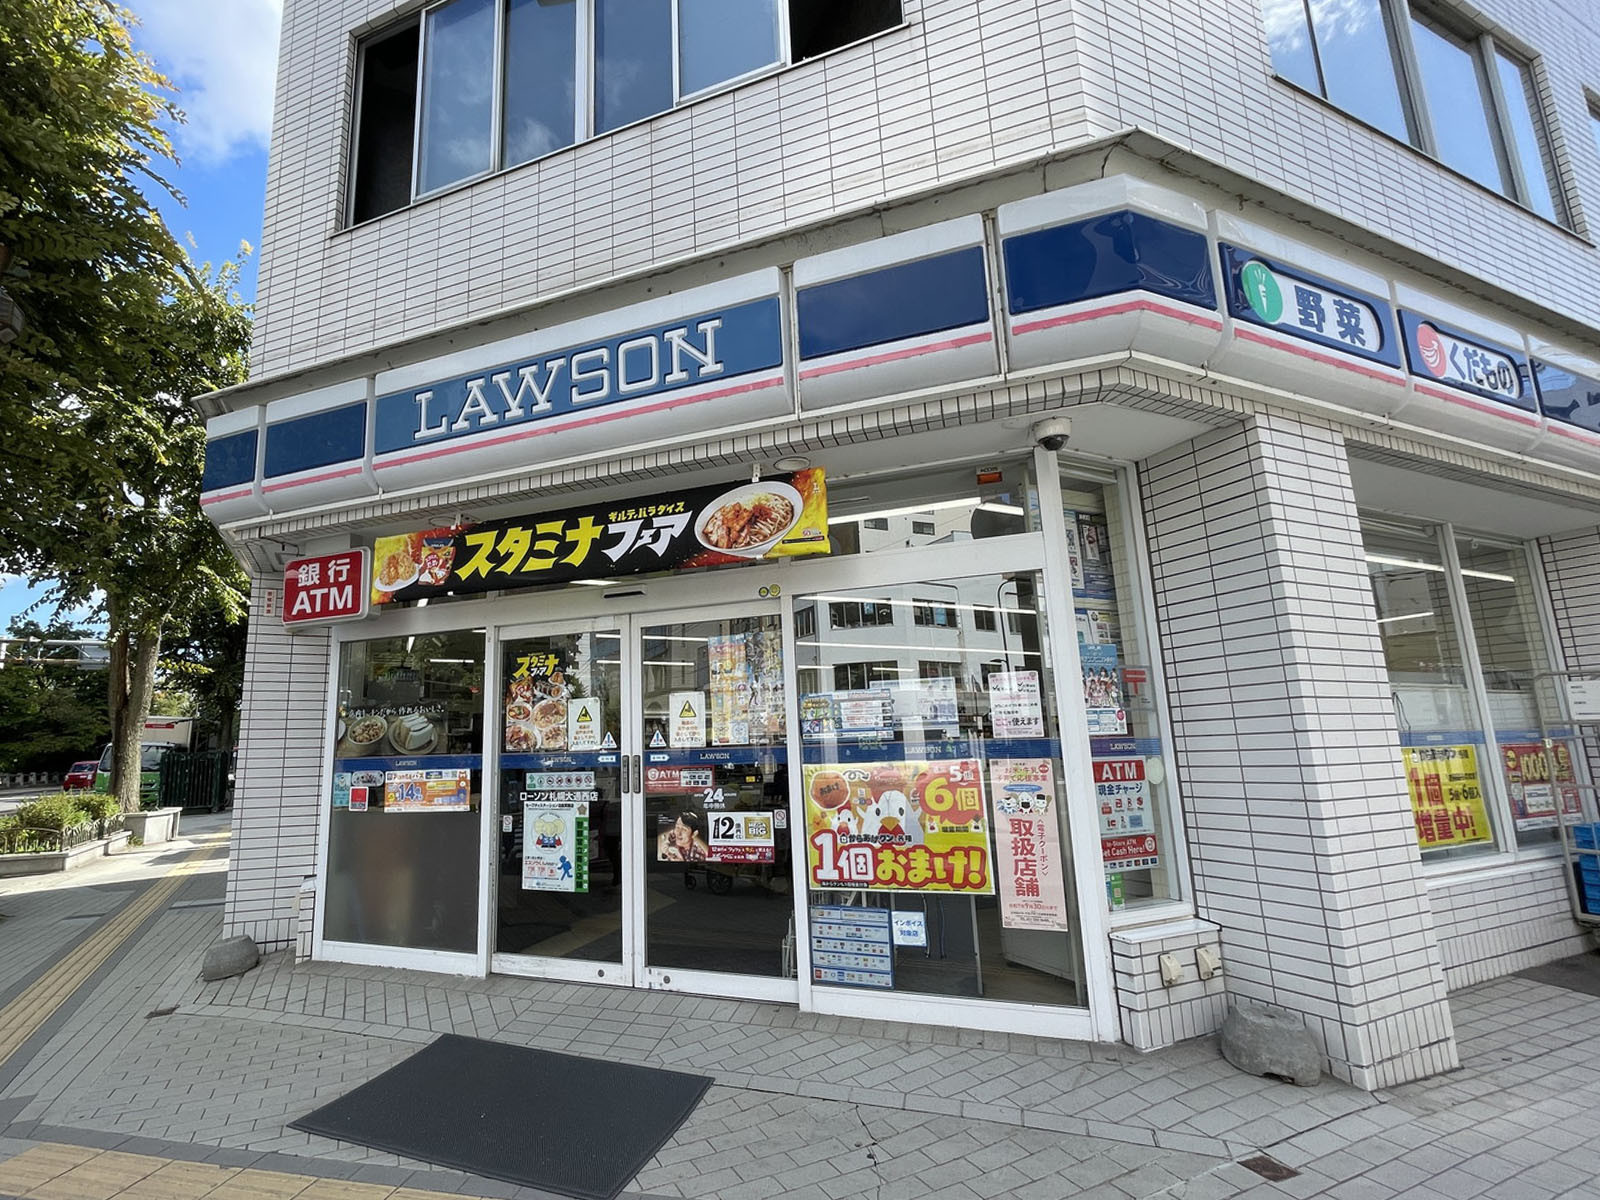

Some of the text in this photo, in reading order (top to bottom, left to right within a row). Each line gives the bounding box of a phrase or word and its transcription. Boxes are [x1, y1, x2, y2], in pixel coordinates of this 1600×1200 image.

[1293, 284, 1367, 348] 野菜
[413, 316, 724, 441] LAWSON
[1448, 341, 1515, 396] くだもの
[455, 510, 693, 582] スタミナ フェア
[297, 558, 350, 587] 銀行
[291, 585, 353, 616] ATM
[513, 653, 560, 678] スタミナ
[700, 752, 730, 760] LAWSON
[660, 769, 680, 779] ATM
[1101, 762, 1138, 781] ATM
[703, 787, 725, 803] 24
[924, 777, 979, 812] 6個
[1097, 782, 1143, 796] 現金チャージ
[1409, 767, 1445, 808] 1個
[712, 816, 735, 840] 12
[1415, 804, 1478, 843] 増量中!
[814, 832, 983, 885] 1個おまけ!
[1008, 817, 1040, 898] 取扱店舗
[1112, 846, 1128, 857] Cash
[1128, 843, 1146, 855] Here!
[894, 920, 923, 928] インボイス
